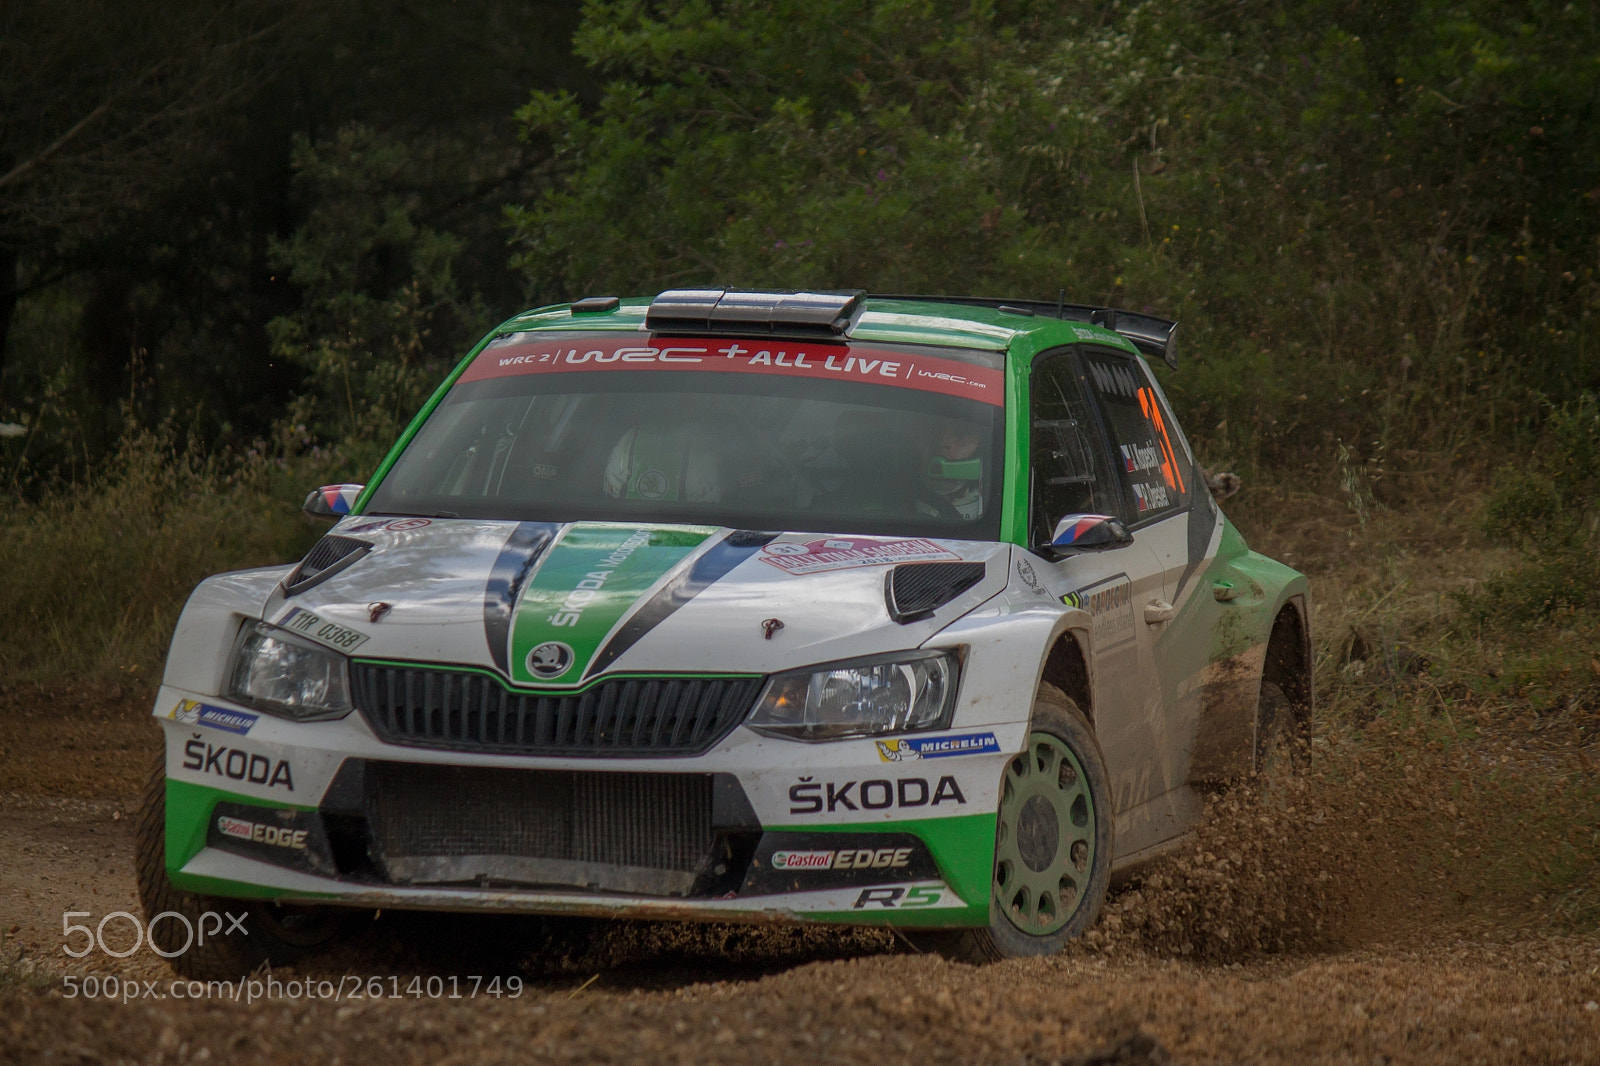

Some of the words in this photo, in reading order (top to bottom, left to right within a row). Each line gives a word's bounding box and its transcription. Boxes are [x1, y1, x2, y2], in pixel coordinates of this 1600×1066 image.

[499, 354, 535, 367] WRC
[538, 354, 550, 362] 2
[748, 351, 812, 368] ALL
[824, 355, 901, 377] LIVE
[771, 554, 824, 570] RALLY
[819, 547, 867, 564] ITALIA
[861, 539, 947, 559] SARDEGNA
[857, 556, 894, 565] 2018
[546, 570, 614, 628] ŠKODA
[291, 612, 319, 631] 11R
[317, 623, 360, 648] 0368
[203, 710, 255, 728] MICHELIN
[920, 736, 996, 752] MICHELIN
[183, 733, 294, 791] ŠKODA
[788, 775, 967, 815] ŠKODA
[253, 823, 309, 849] EDGE
[787, 852, 831, 867] Castrol
[832, 848, 915, 869] EDGE
[853, 884, 947, 909] R5
